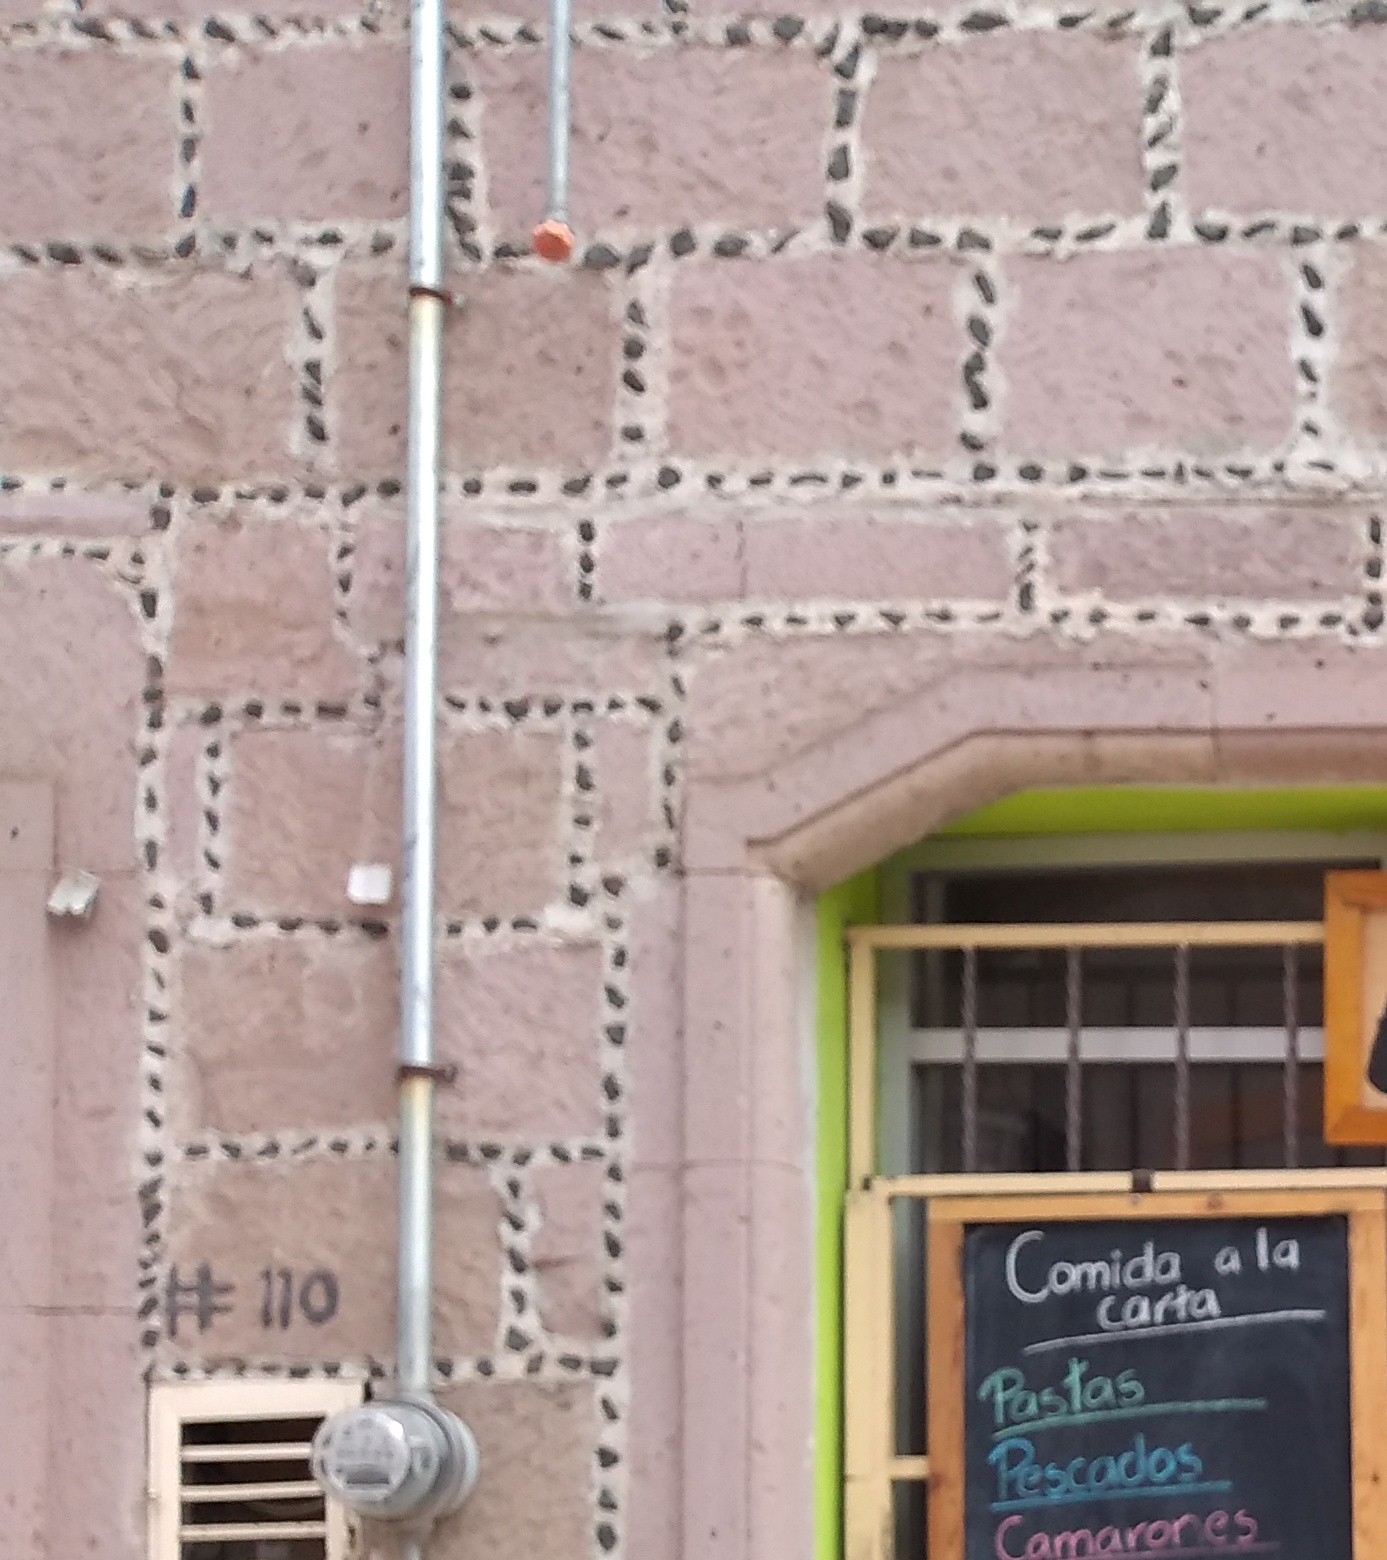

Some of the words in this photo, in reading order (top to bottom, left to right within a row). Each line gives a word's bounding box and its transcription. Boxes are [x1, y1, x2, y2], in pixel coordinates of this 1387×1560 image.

[1006, 1230, 1182, 1303] Comida
[1214, 1243, 1242, 1277] a
[1256, 1226, 1301, 1270] la
[261, 1267, 340, 1330] 110
[1097, 1284, 1222, 1332] carta
[977, 1357, 1146, 1425] Pastas
[987, 1433, 1203, 1498] Pescados
